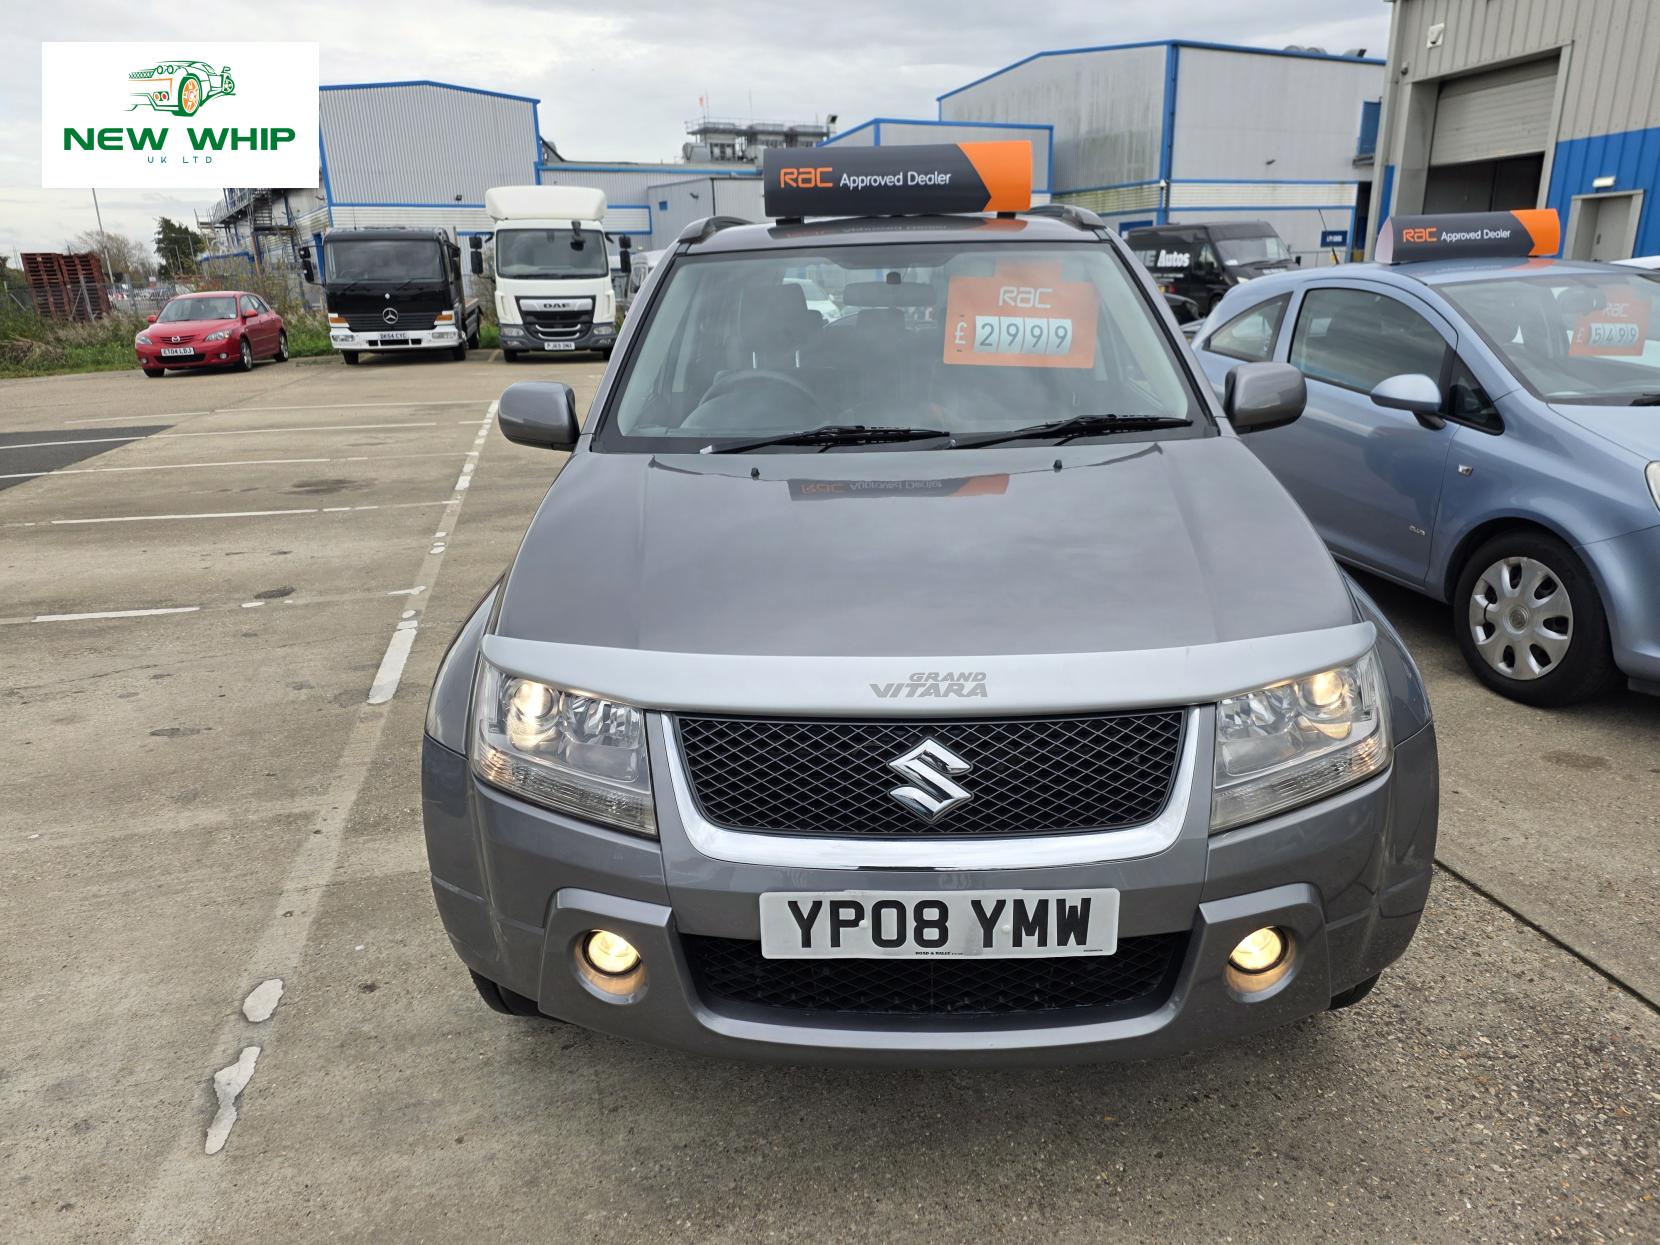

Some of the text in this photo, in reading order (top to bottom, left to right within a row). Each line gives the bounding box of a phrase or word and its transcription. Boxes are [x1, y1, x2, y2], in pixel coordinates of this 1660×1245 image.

[840, 172, 903, 191] Approved
[907, 170, 952, 186] Dealer
[1440, 228, 1482, 244] Approved
[1483, 228, 1511, 239] Dealer
[1157, 250, 1190, 267] Autos
[909, 672, 987, 682] GRAND
[869, 683, 988, 698] VITARA
[787, 897, 1092, 949] YP08 YMW
